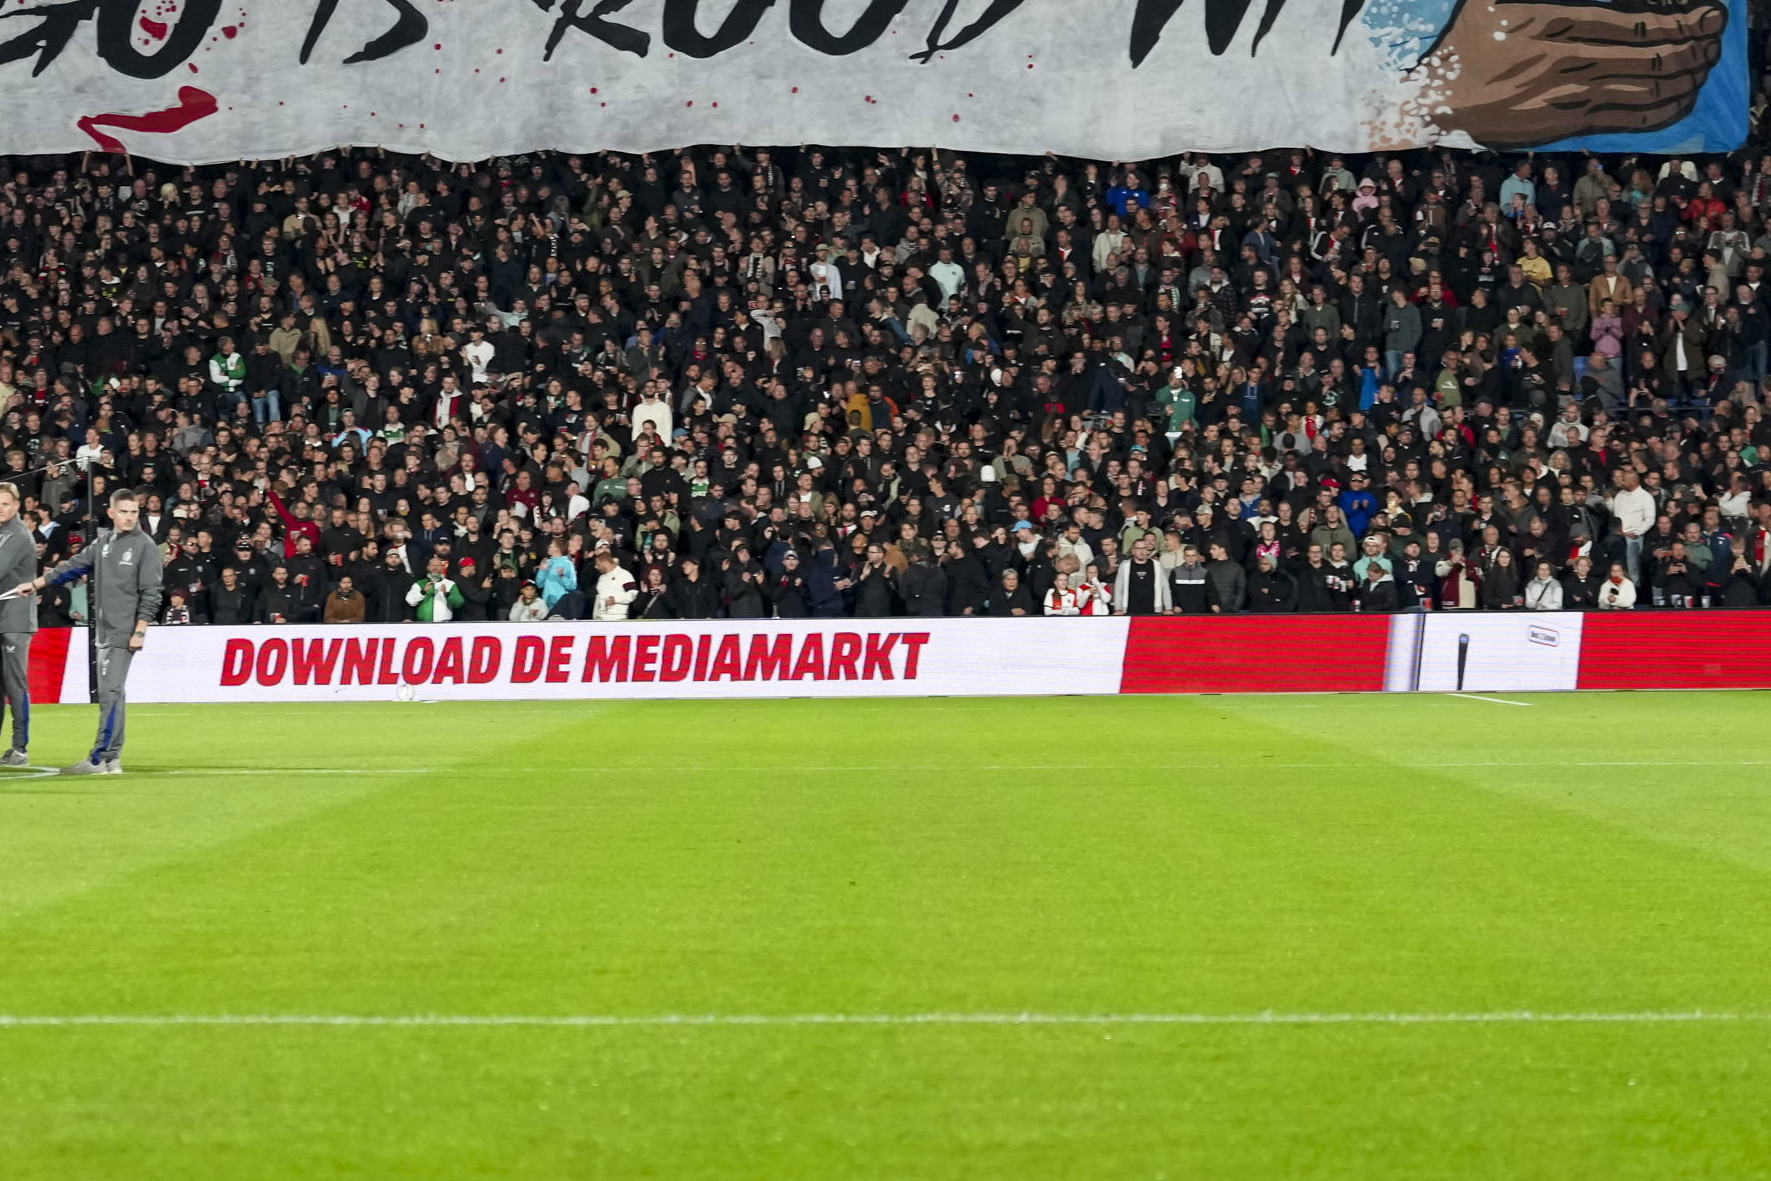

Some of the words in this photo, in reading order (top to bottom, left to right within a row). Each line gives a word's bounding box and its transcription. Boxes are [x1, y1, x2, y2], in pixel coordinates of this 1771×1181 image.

[219, 635, 502, 688] DOWNLOAD
[510, 635, 574, 685] DE
[580, 631, 931, 684] MEDIAMARKT
